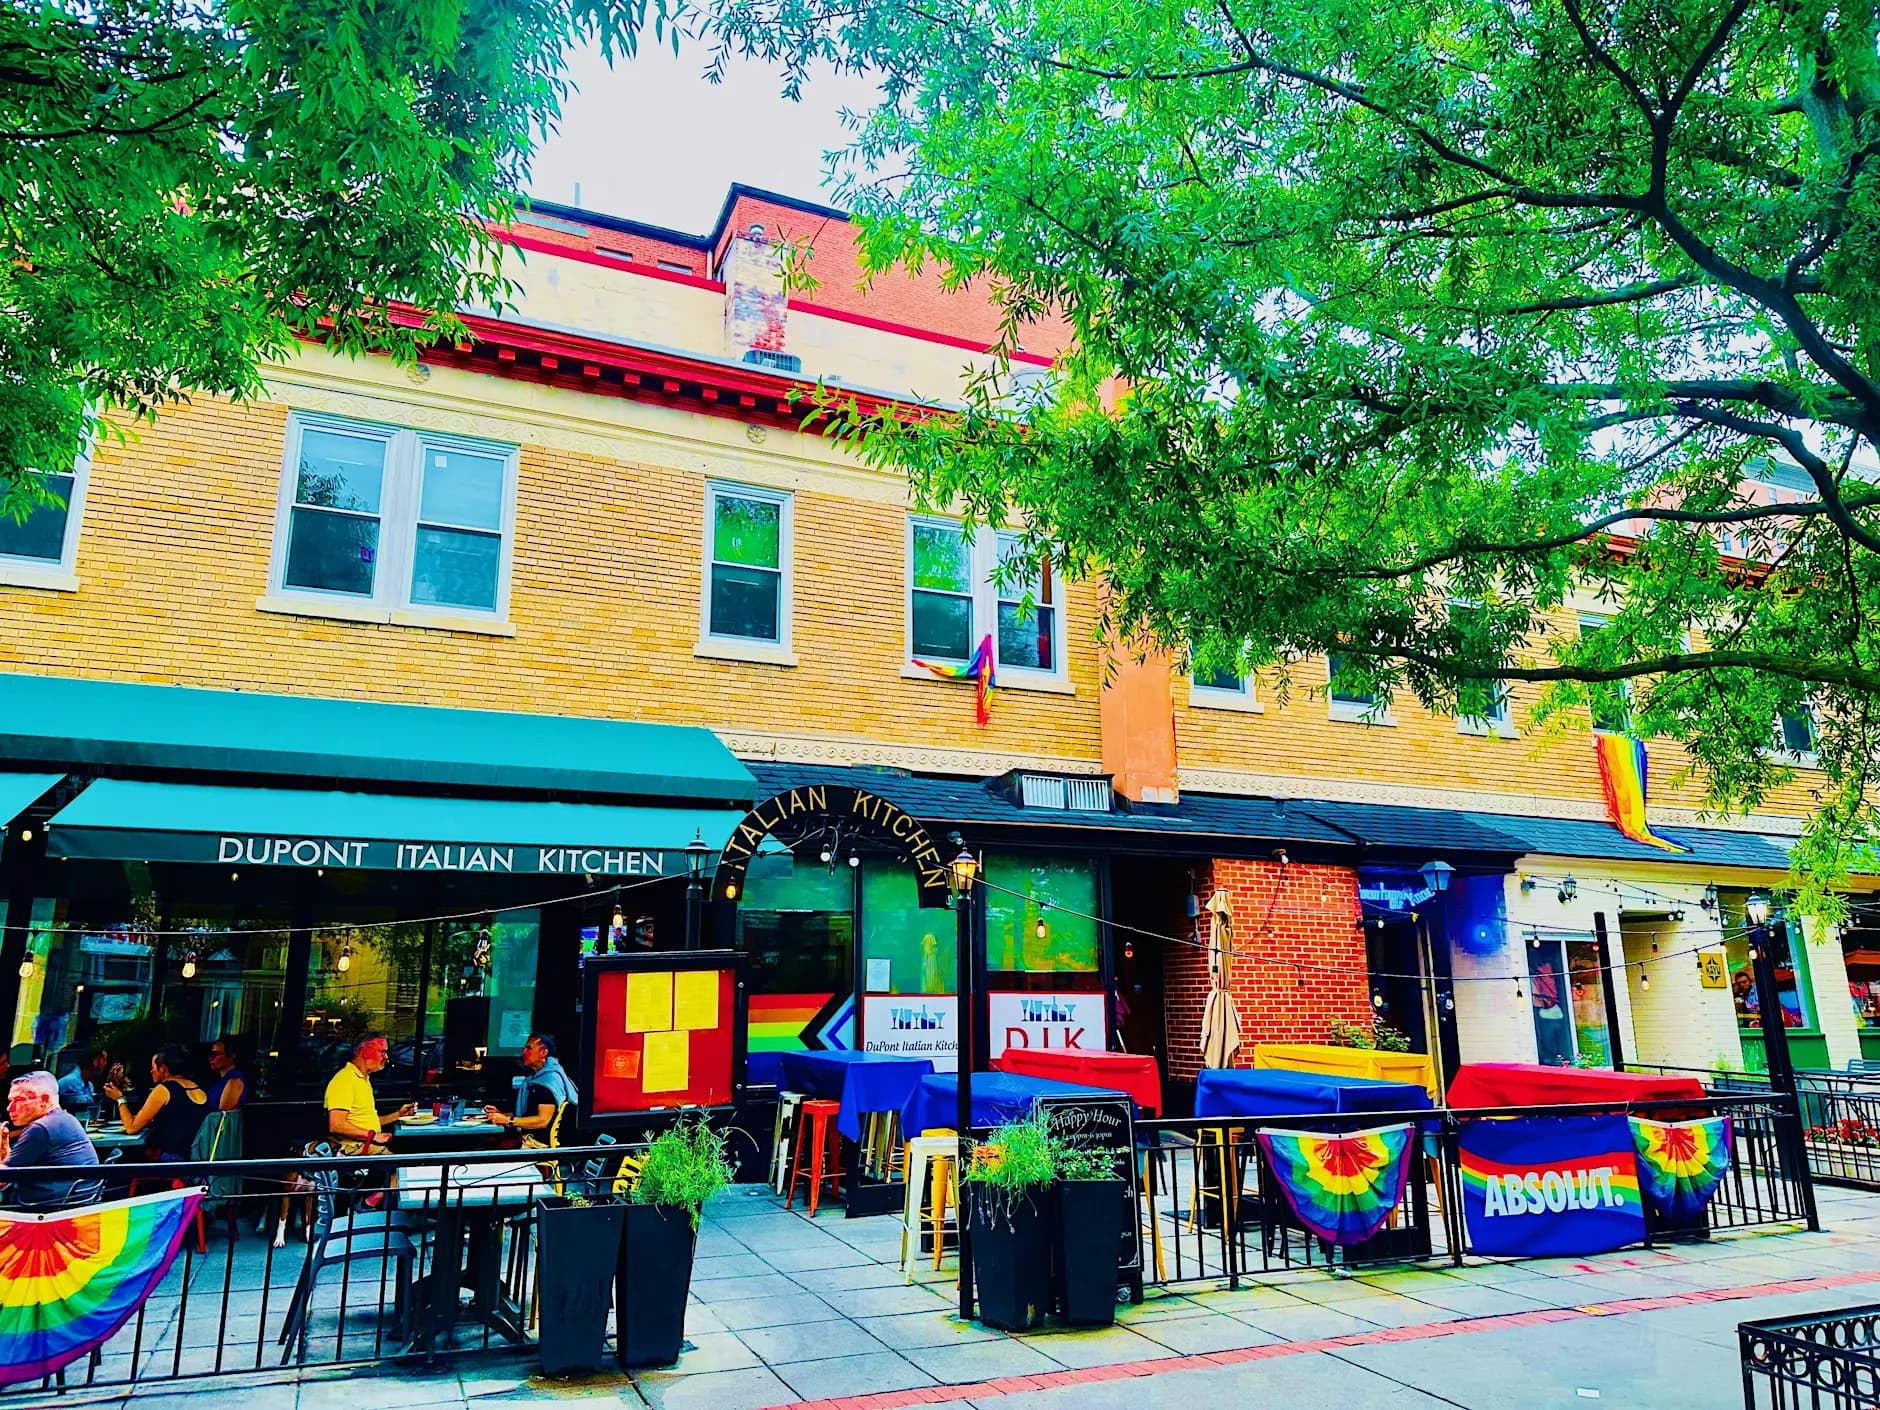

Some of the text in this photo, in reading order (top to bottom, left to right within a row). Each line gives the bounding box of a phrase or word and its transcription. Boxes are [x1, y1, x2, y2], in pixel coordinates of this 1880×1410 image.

[721, 786, 946, 888] ITALIAN KITCHEN
[218, 837, 664, 875] DUPONT ITALIAN KITCHEN
[865, 1039, 959, 1052] DuPont Italian Kitch
[1049, 1108, 1122, 1130] Happy Hour
